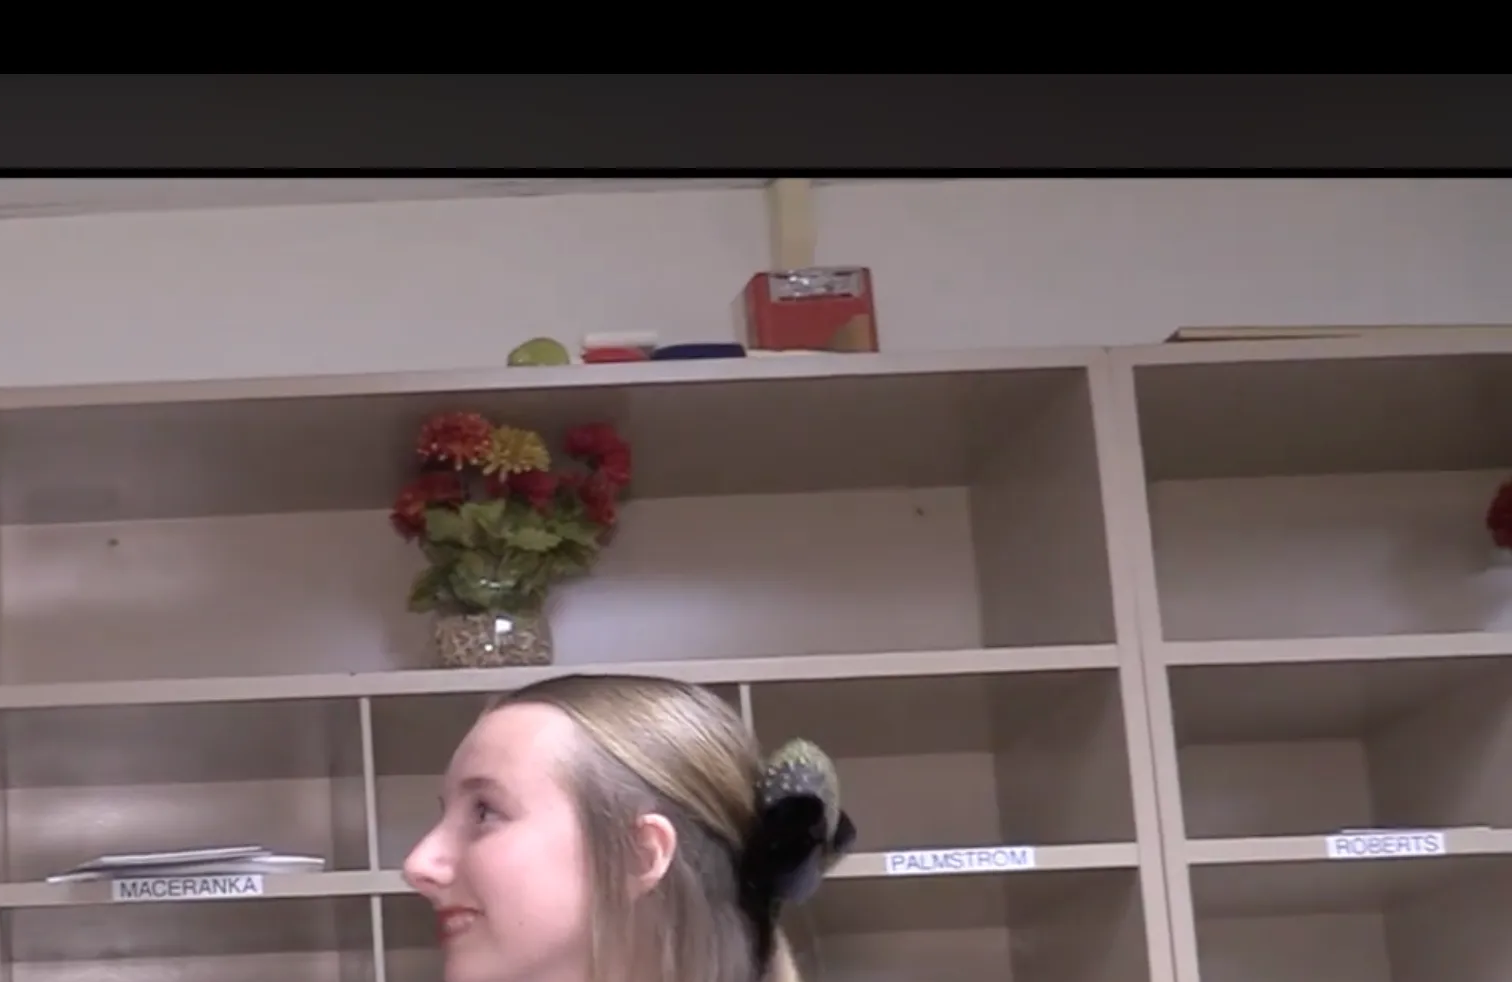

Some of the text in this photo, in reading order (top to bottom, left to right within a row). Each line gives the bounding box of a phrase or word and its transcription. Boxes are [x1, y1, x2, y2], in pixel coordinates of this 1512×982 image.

[1335, 834, 1440, 855] ROBERTS
[890, 850, 1028, 871] PALMSTROM
[119, 877, 258, 899] MACERANKA
